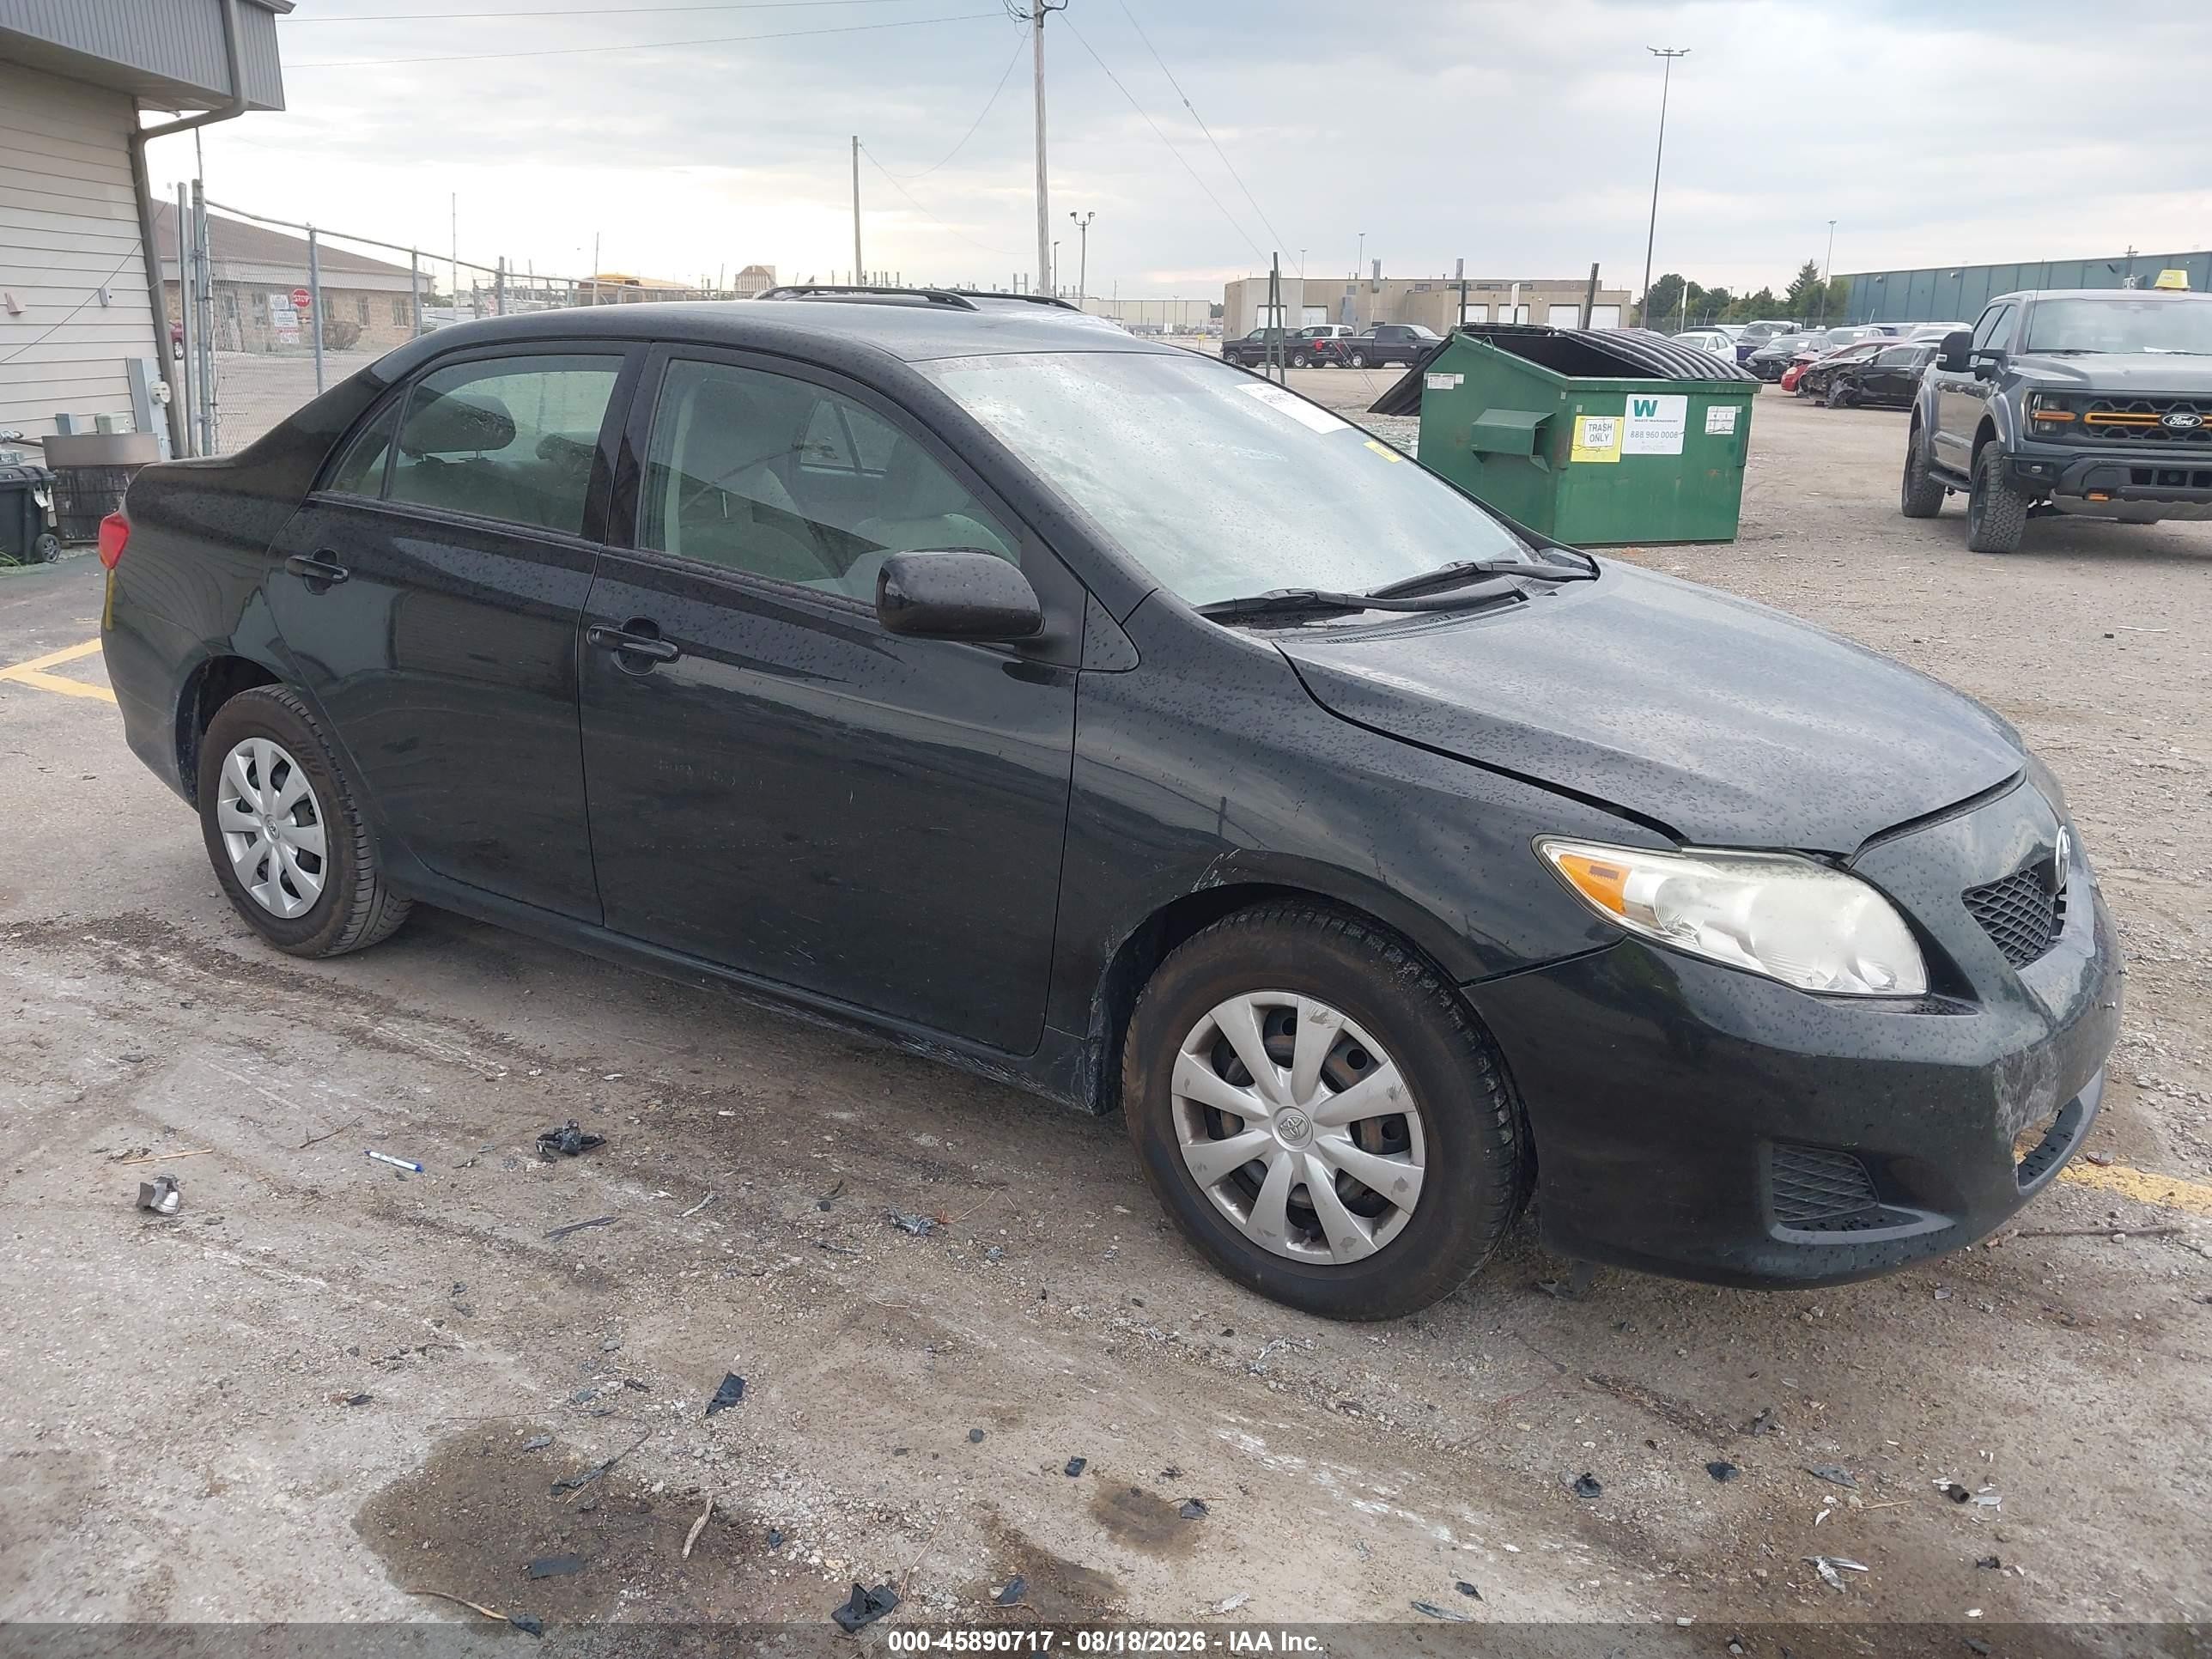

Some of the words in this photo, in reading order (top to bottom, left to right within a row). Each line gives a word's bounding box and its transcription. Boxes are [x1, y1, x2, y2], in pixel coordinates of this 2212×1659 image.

[2169, 415, 2196, 425] Ford
[1588, 422, 1613, 432] TRASH
[1589, 433, 1609, 442] ONLY
[1630, 430, 1644, 439] 888
